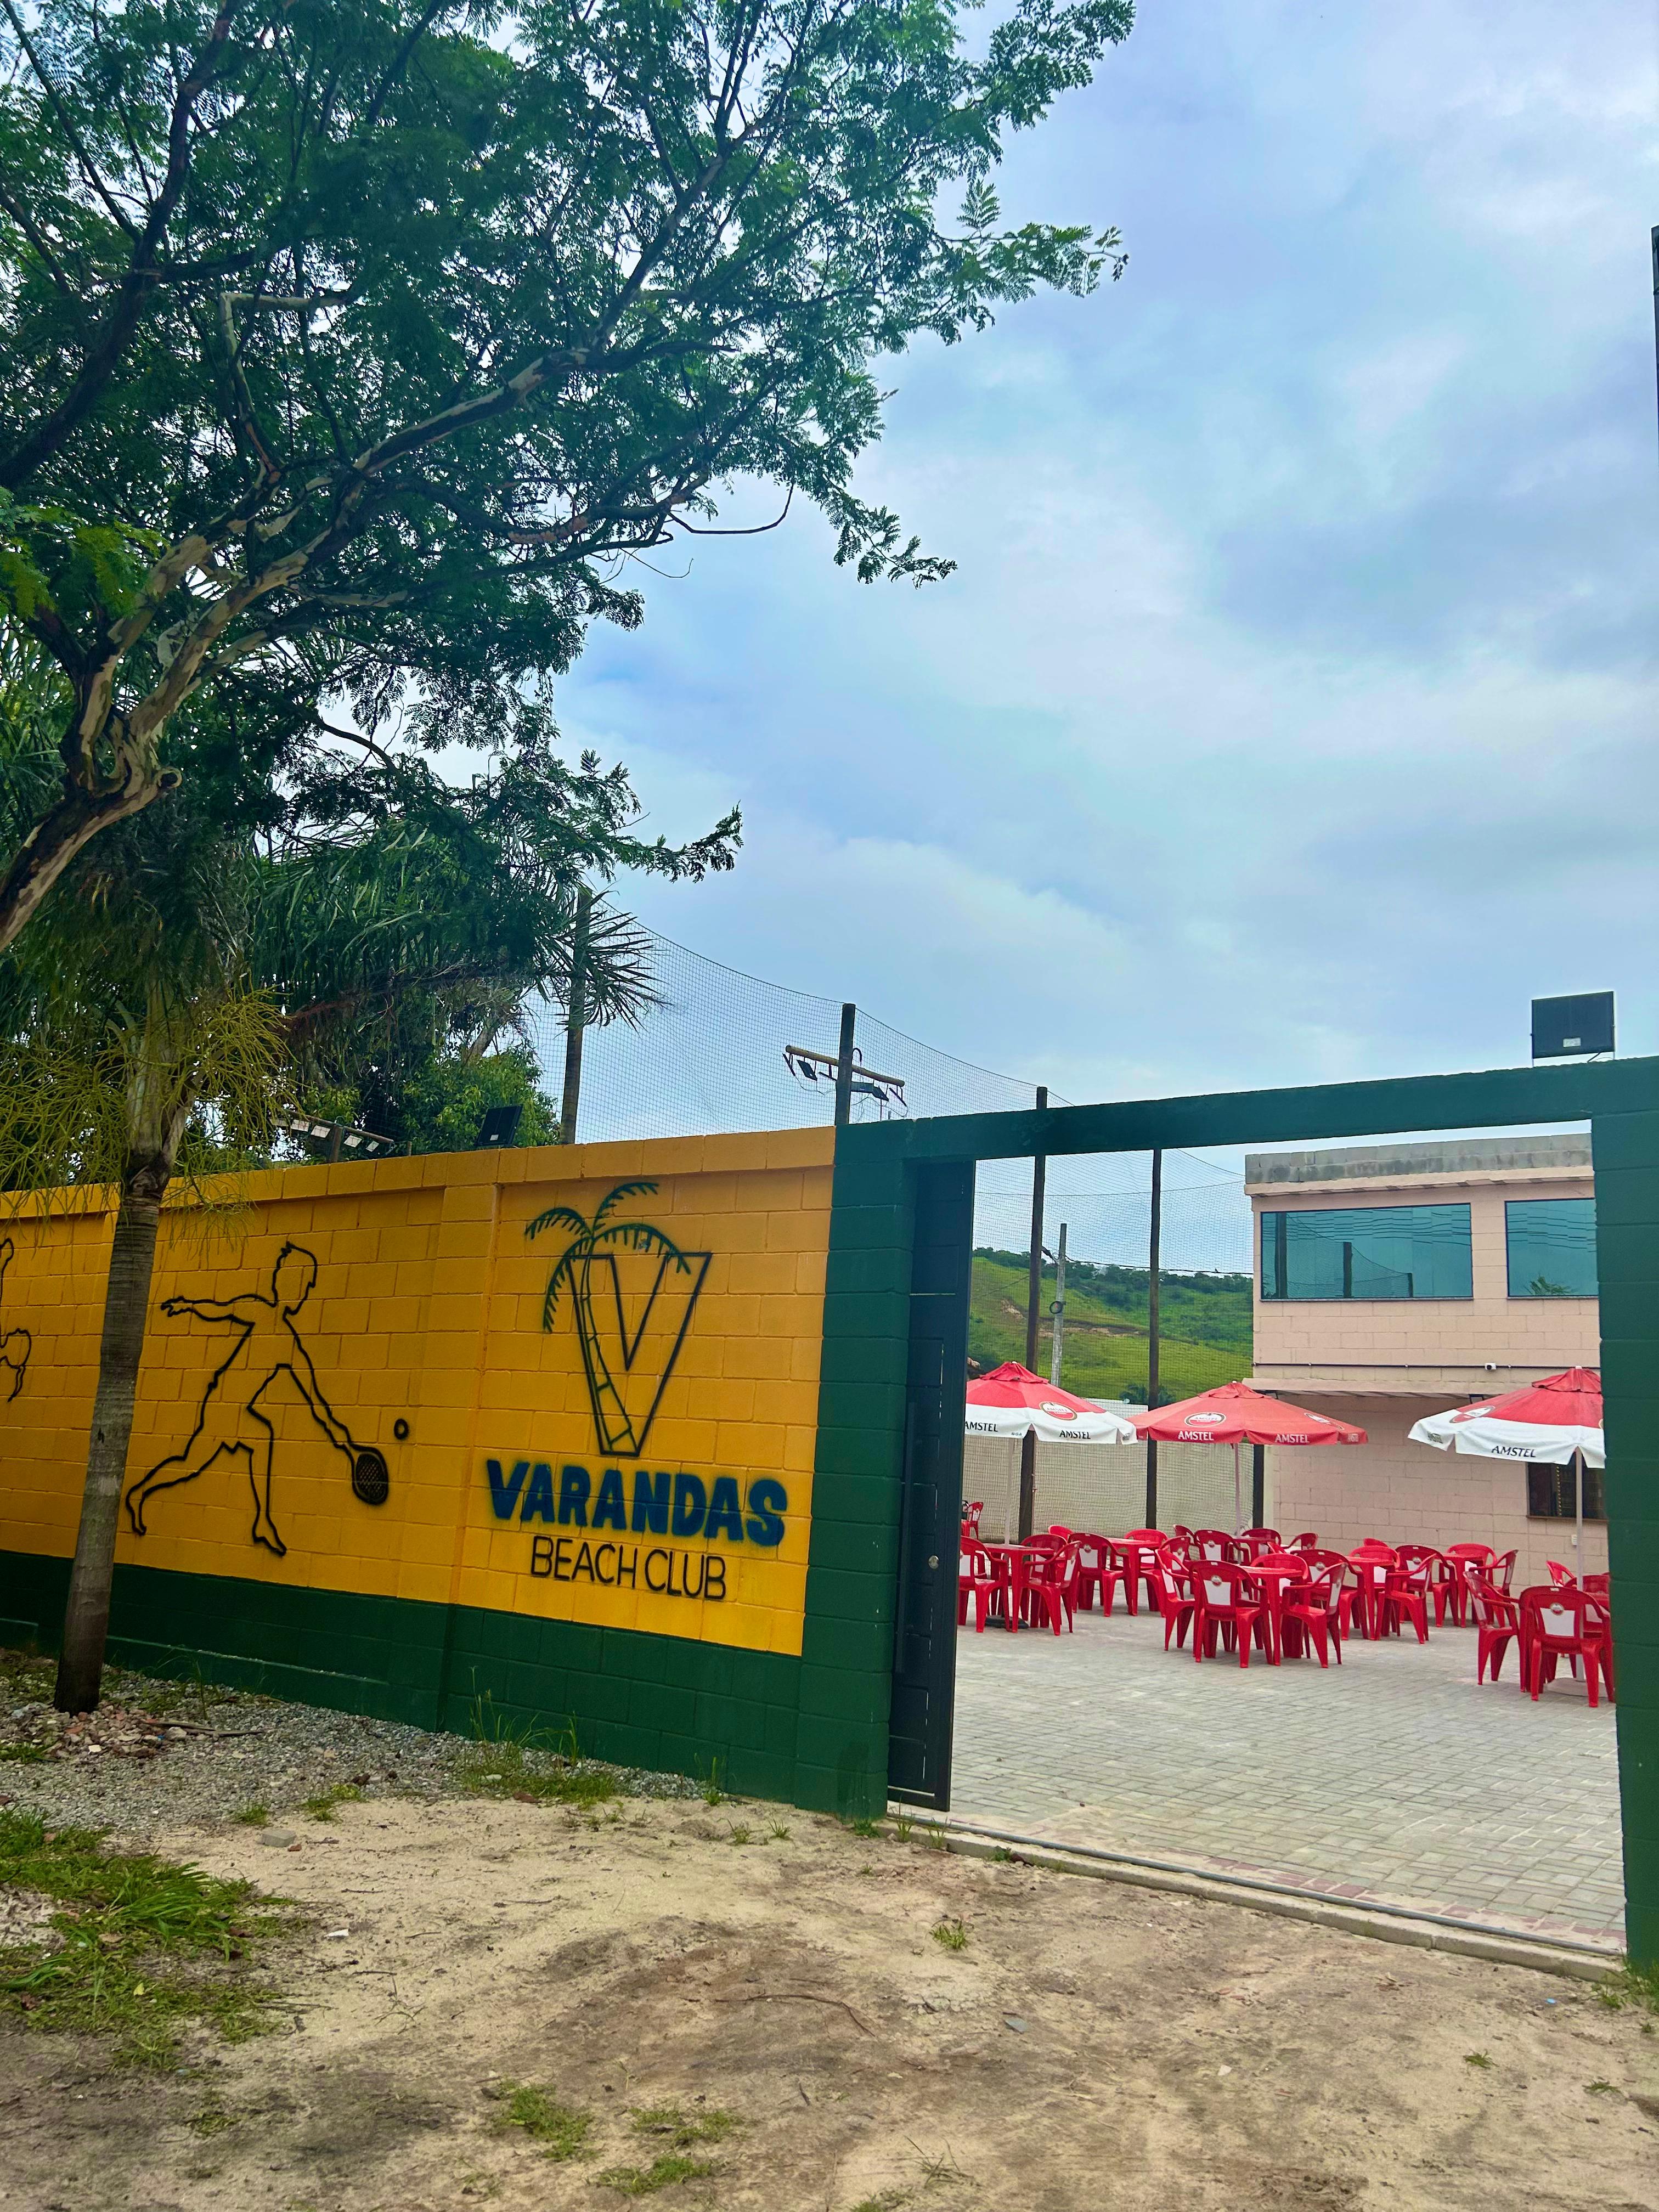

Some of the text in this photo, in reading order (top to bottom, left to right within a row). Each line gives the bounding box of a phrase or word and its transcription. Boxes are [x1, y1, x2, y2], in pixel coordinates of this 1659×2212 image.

[964, 1421, 998, 1432] AMSTEL
[1059, 1430, 1091, 1440] AMSTEL
[1178, 1430, 1214, 1441] AMSTEL
[1274, 1433, 1310, 1443] AMSTEL
[1491, 1446, 1537, 1458] AMSTEL
[487, 1459, 787, 1547] VARANDAS
[531, 1536, 726, 1600] BEACH CLUB
